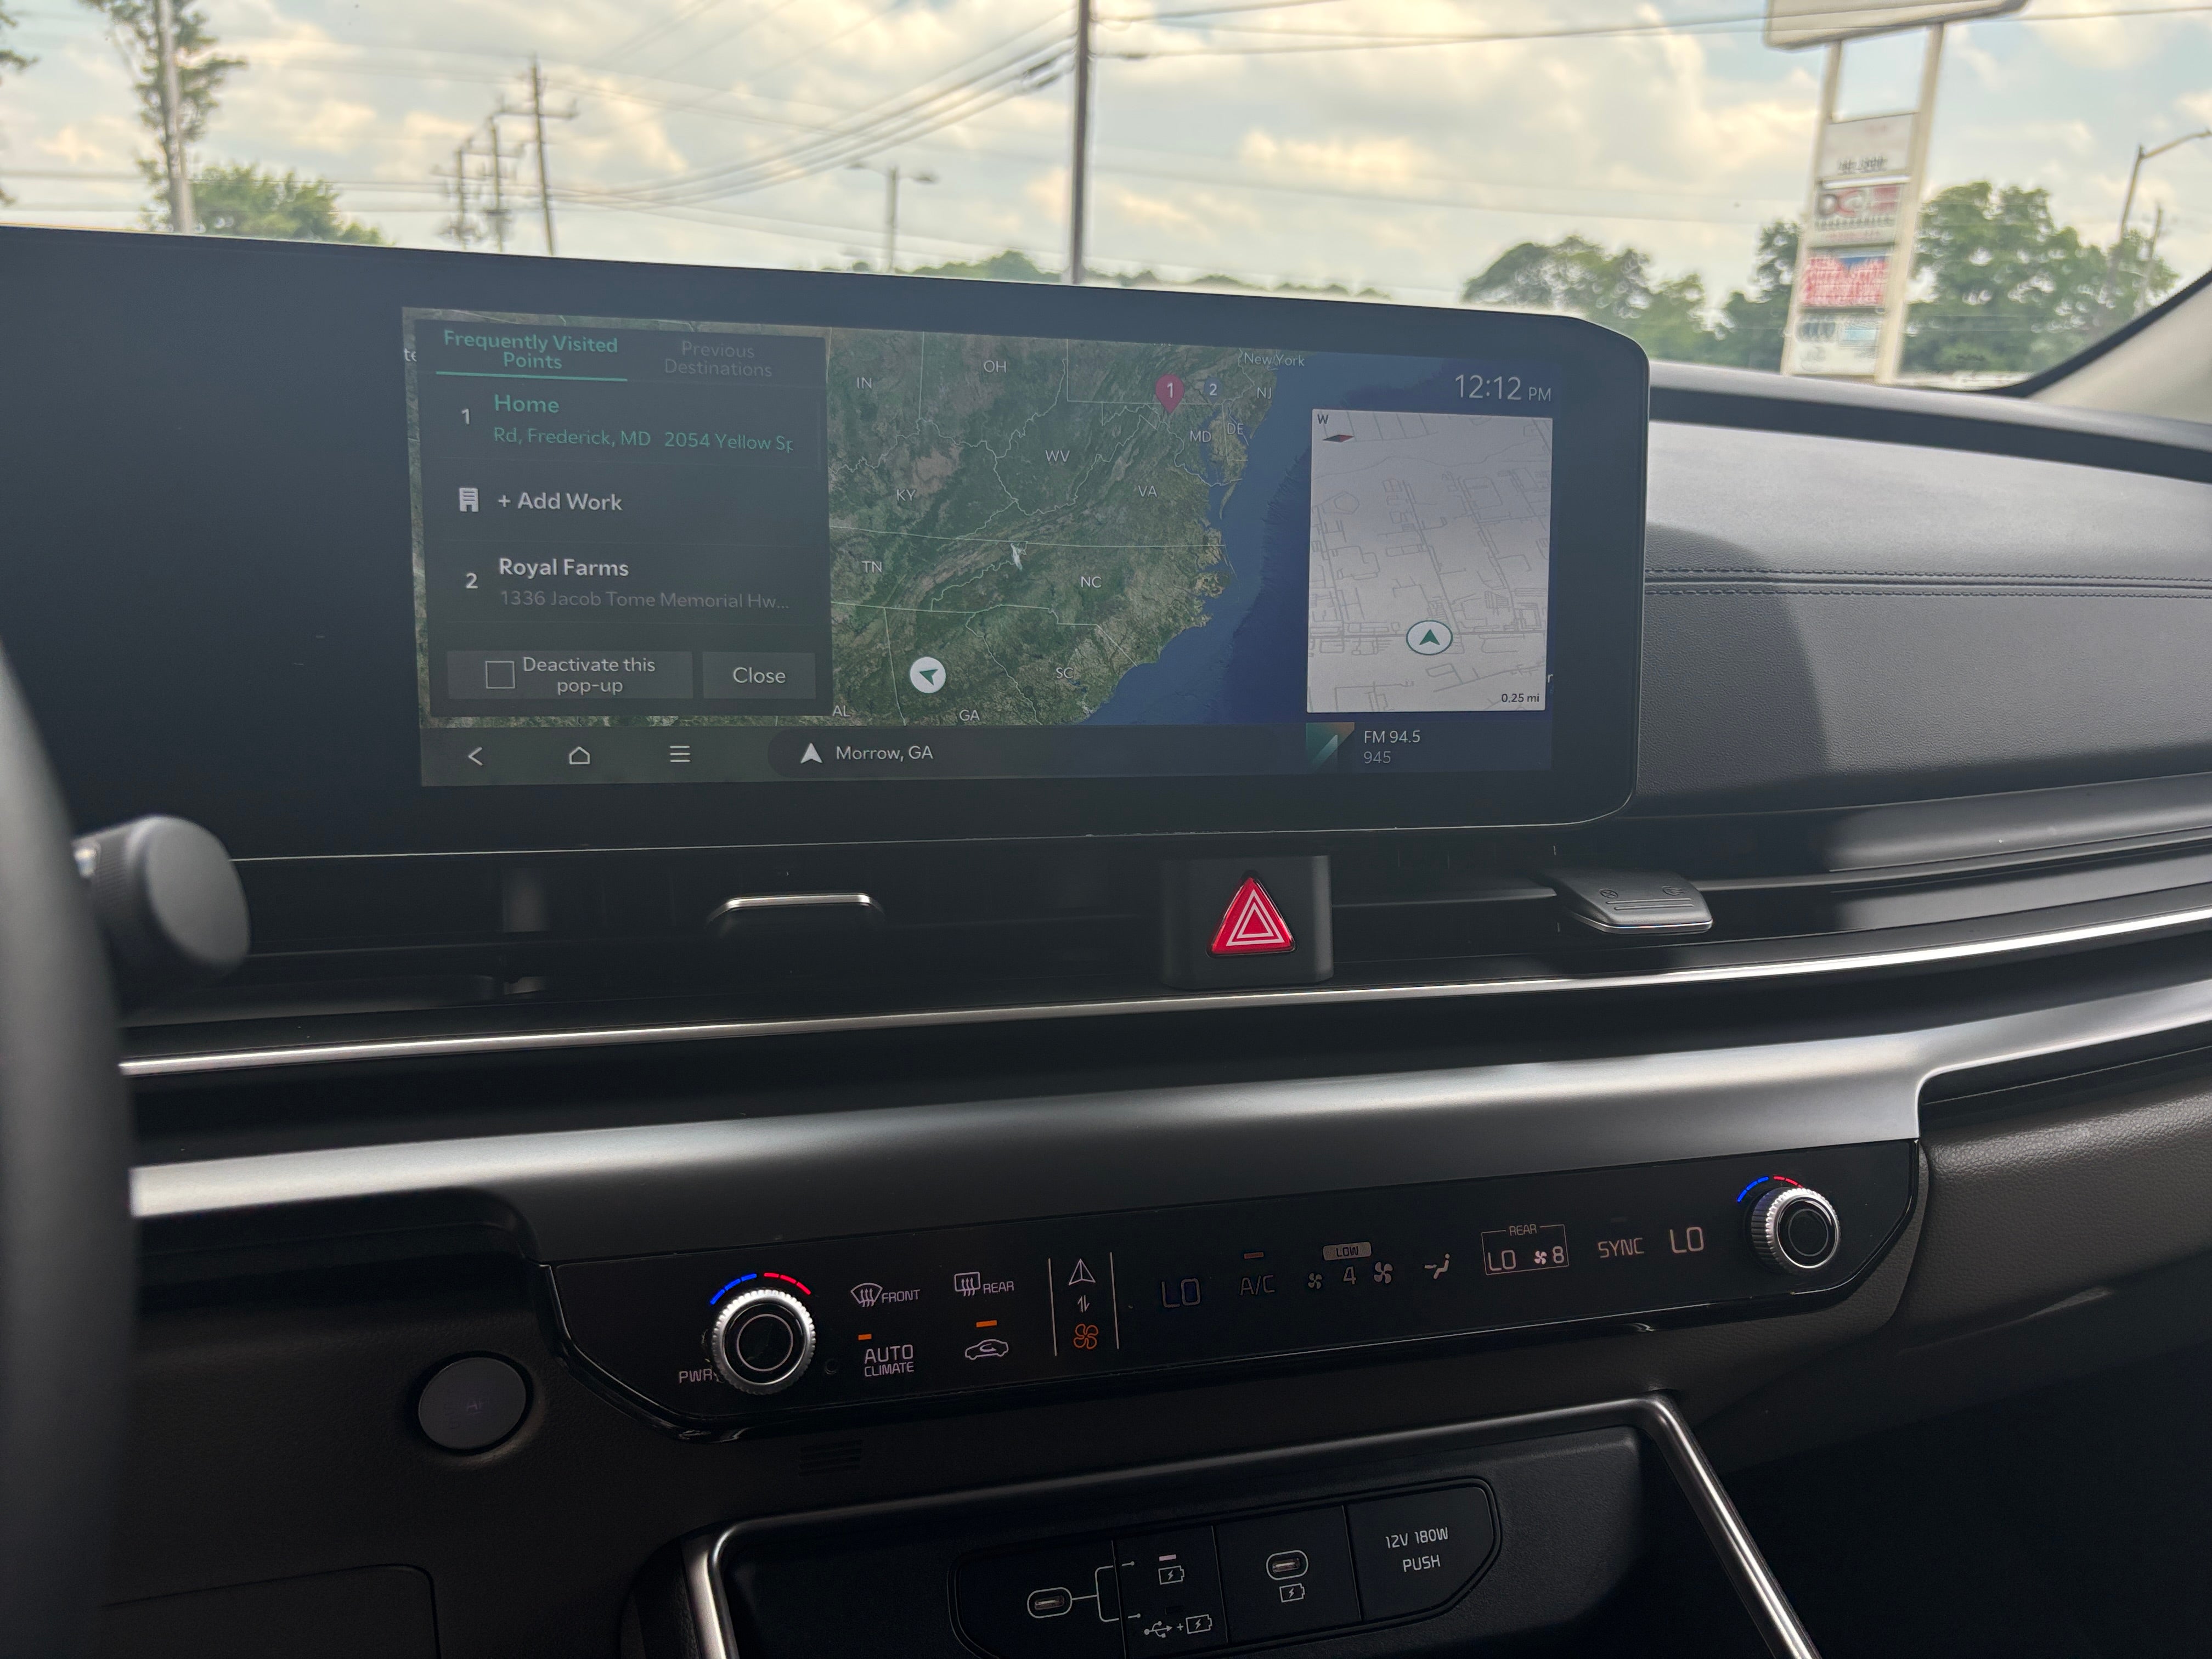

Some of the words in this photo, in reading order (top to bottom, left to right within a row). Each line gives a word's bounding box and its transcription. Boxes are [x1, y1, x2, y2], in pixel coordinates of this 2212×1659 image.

[443, 330, 549, 354] Frequently
[553, 335, 618, 353] Visited
[681, 340, 754, 359] Previous
[504, 352, 562, 370] Points
[984, 360, 1006, 373] OH
[1244, 353, 1273, 365] New
[1276, 354, 1305, 366] York
[664, 358, 772, 377] Destinations
[856, 377, 872, 389] IN
[1166, 383, 1173, 397] 1
[1209, 384, 1217, 396] 2
[1455, 375, 1522, 400] 12:12
[1528, 387, 1551, 402] PM
[1256, 387, 1272, 399] NJ
[494, 394, 560, 413] Home
[461, 408, 471, 425] 1
[1318, 415, 1328, 424] W
[1190, 431, 1211, 442] MD
[1227, 423, 1244, 435] DE
[494, 427, 522, 444] Rd,
[528, 428, 615, 447] Frederick,
[621, 431, 651, 446] MD
[664, 432, 710, 447] 2054
[714, 433, 770, 449] Yellow
[1045, 450, 1070, 462] WV
[896, 489, 916, 501] KY
[1138, 485, 1158, 498] VA
[517, 492, 561, 510] Add
[567, 493, 623, 511] Work
[499, 558, 557, 579] Royal
[563, 559, 629, 577] Farms
[862, 561, 882, 573] TN
[466, 573, 478, 589] 2
[1081, 576, 1102, 588] NC
[501, 590, 545, 606] 1336
[551, 590, 601, 607] Jacob
[604, 592, 655, 607] Tome
[661, 593, 743, 609] Memorial
[523, 657, 618, 673] Deactivate
[623, 657, 656, 673] this
[733, 667, 786, 684] Close
[1056, 667, 1074, 679] SC
[557, 679, 623, 696] pop-up
[1501, 693, 1524, 703] 0.25
[1527, 693, 1539, 703] mi
[832, 706, 851, 717] AL
[959, 710, 980, 721] GA
[1364, 731, 1385, 743] FM
[1389, 731, 1420, 743] 94.5
[836, 746, 904, 761] Morrow,
[909, 746, 933, 759] GA
[1363, 751, 1391, 764] 945
[1509, 1223, 1537, 1237] REAR
[1598, 1237, 1644, 1259] SYNC
[1669, 1227, 1705, 1254] LO
[1336, 1245, 1359, 1257] LOW
[1487, 1250, 1516, 1272] LO
[1552, 1246, 1565, 1264] 8
[1343, 1266, 1357, 1285] 4
[983, 1280, 1014, 1294] REAR
[1240, 1274, 1275, 1296] A/C
[882, 1289, 920, 1304] FRONT
[1161, 1278, 1201, 1308] LO
[864, 1345, 913, 1364] AUTO
[679, 1370, 713, 1384] PWR
[865, 1361, 914, 1378] CLIMATE
[1385, 1533, 1408, 1549] 12V
[1414, 1527, 1448, 1544] 180W
[1402, 1554, 1441, 1572] PUSH
